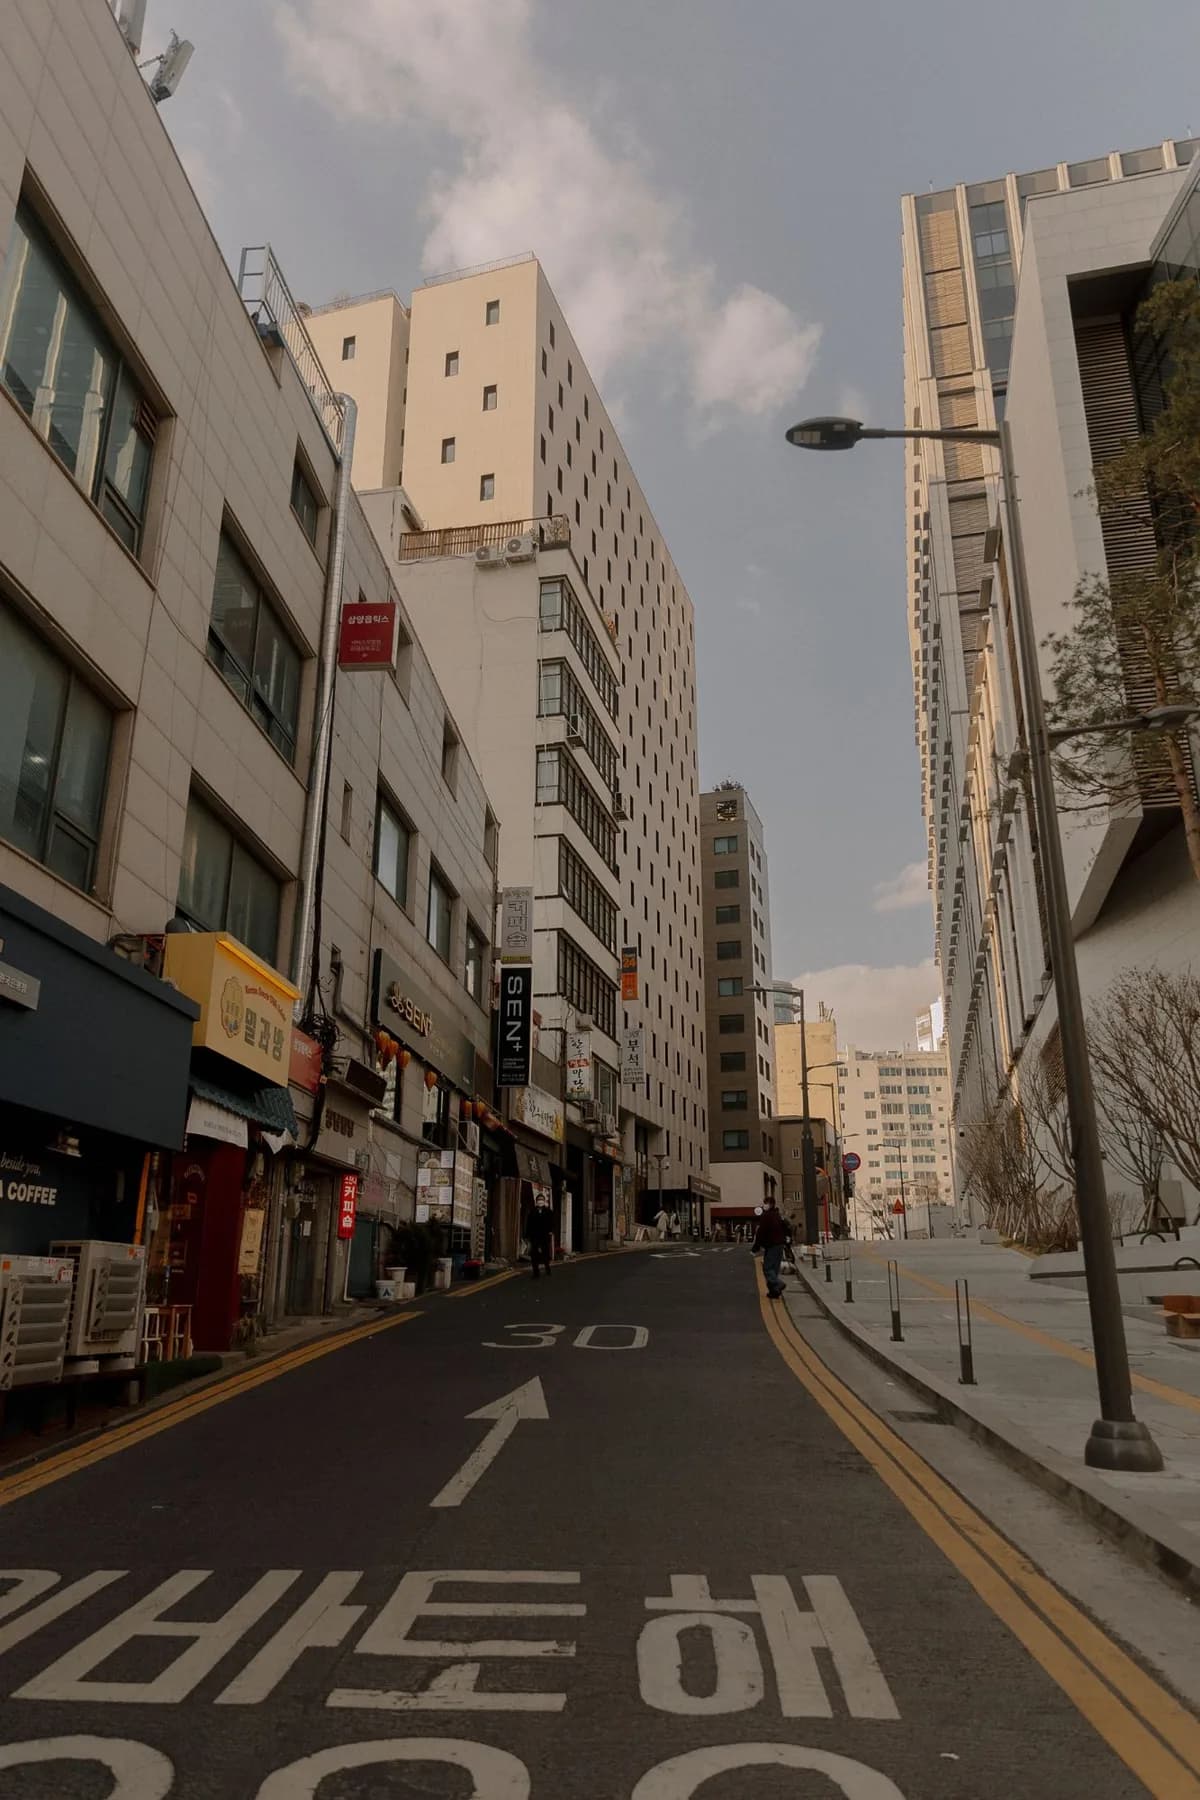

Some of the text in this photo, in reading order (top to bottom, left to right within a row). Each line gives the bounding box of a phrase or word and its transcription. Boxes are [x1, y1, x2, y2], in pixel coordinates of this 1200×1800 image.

[506, 899, 528, 948] 커피숍
[244, 1007, 284, 1062] 밀과방
[627, 1039, 640, 1067] 부석
[7, 1181, 58, 1206] COFFEE
[341, 1186, 355, 1228] 커피숍
[481, 1323, 650, 1351] 30
